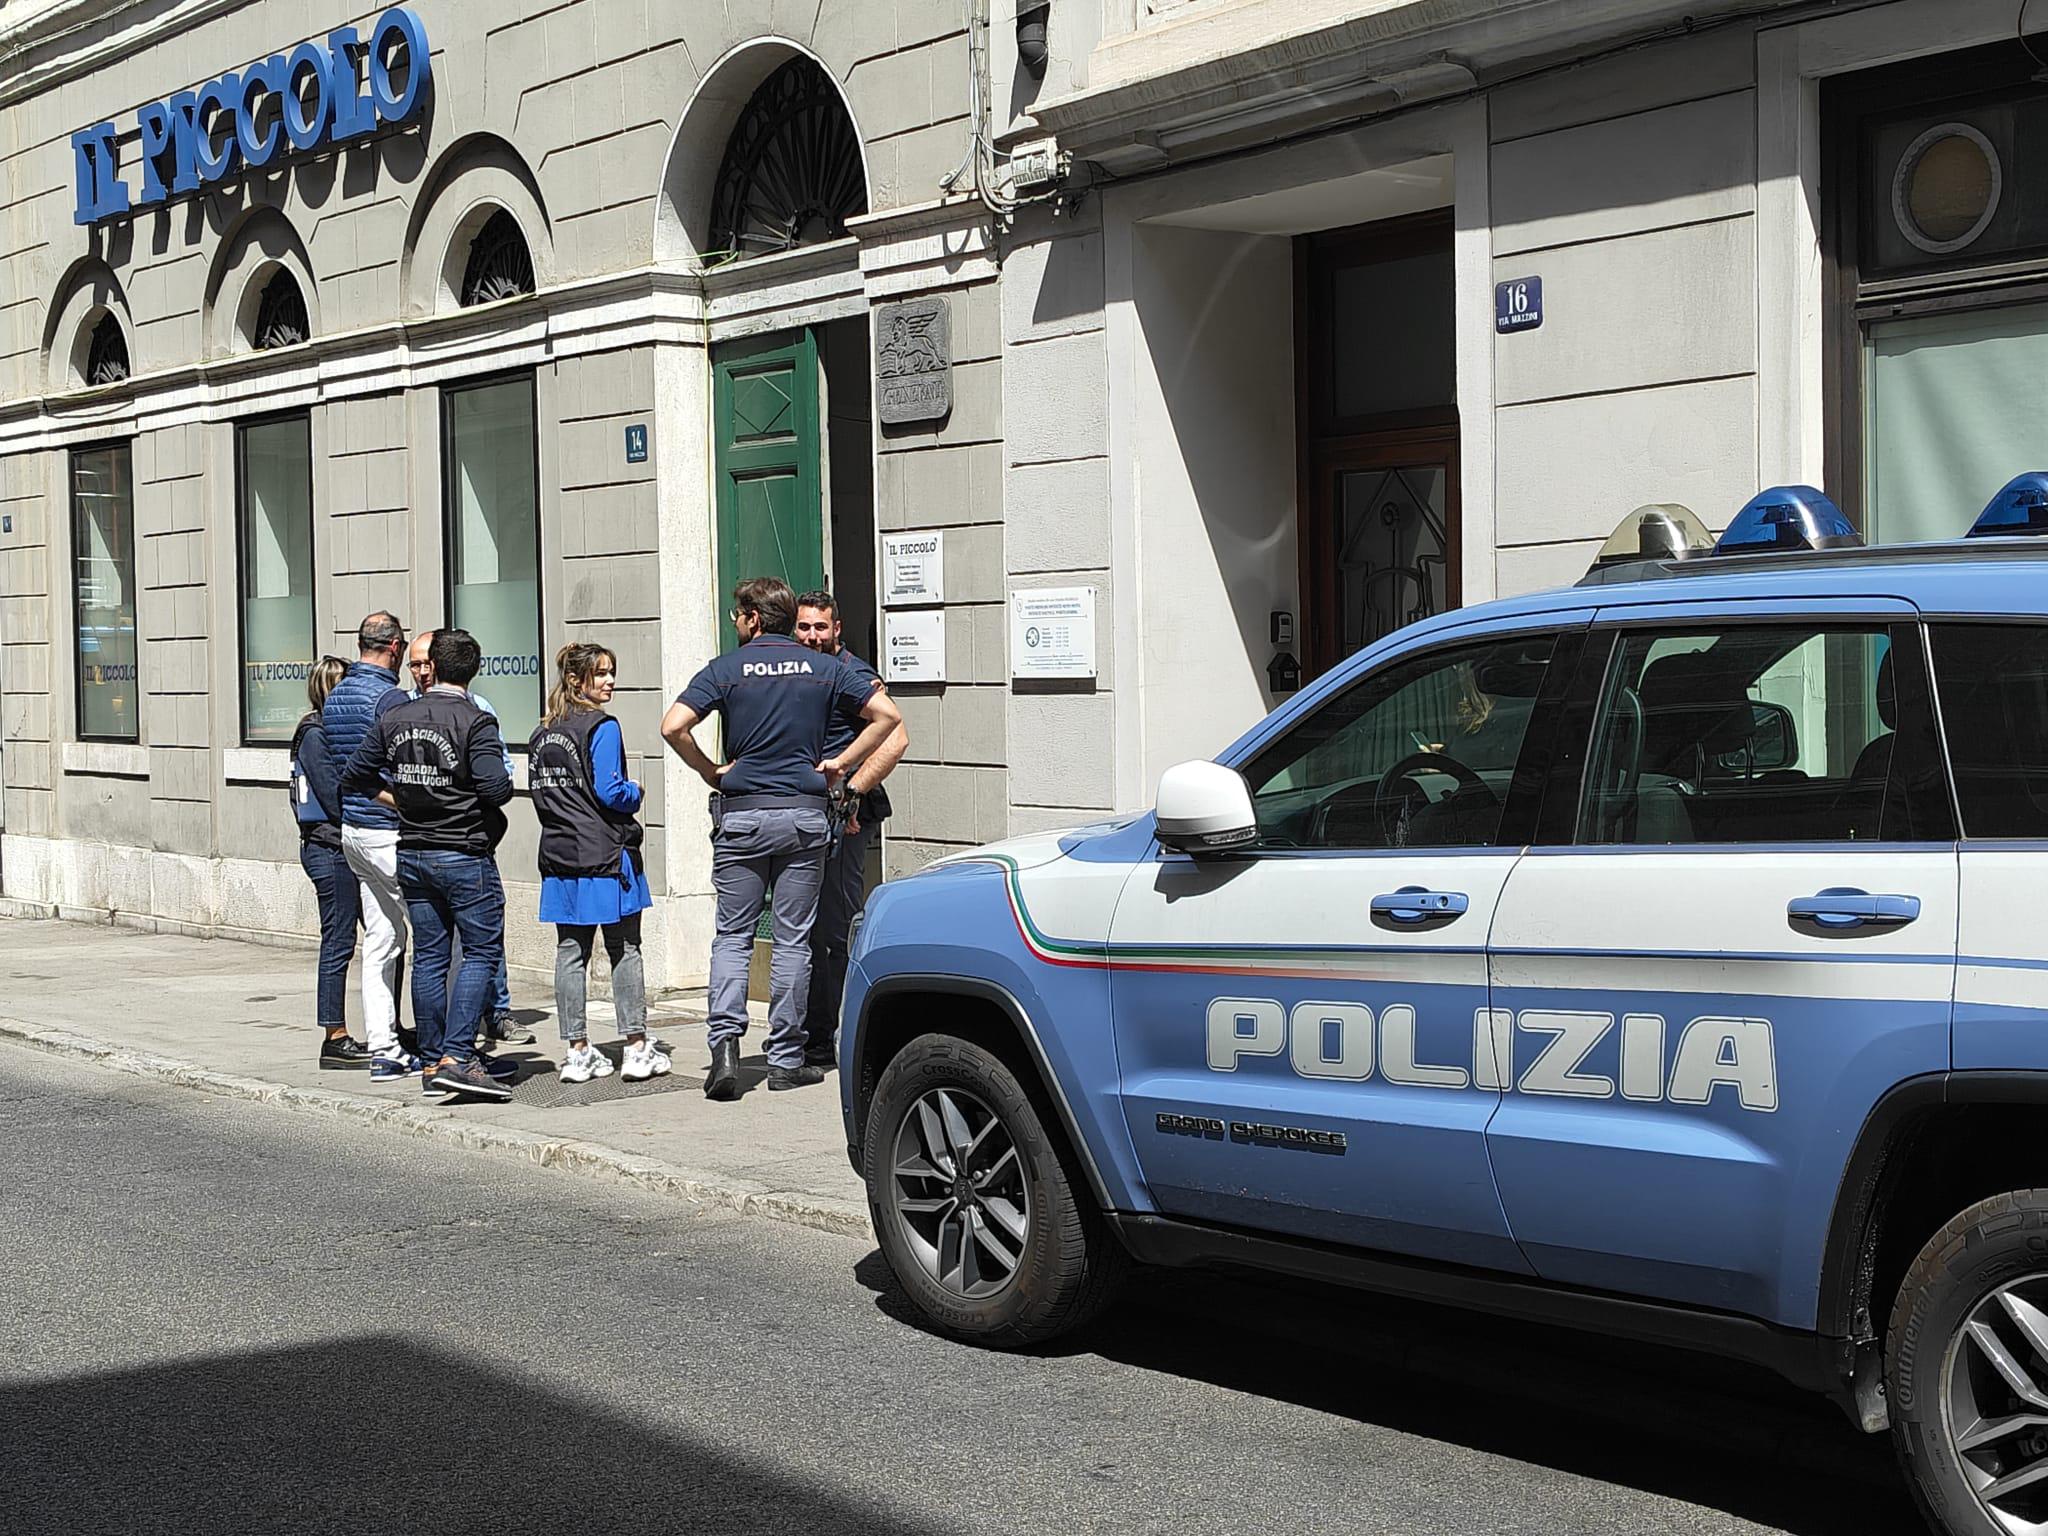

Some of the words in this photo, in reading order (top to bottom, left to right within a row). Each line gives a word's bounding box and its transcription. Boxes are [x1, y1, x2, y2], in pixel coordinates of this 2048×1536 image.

[71, 121, 129, 226] IL
[137, 7, 431, 204] PICCOLO
[1507, 283, 1528, 315] 16
[631, 430, 642, 451] 14
[889, 544, 898, 556] IL
[900, 541, 937, 556] PICCOLO
[251, 665, 263, 681] IL
[479, 654, 539, 676] PICCOLO
[743, 660, 813, 677] POLIZIA
[412, 728, 459, 769] SCIENTIFICA
[397, 763, 438, 776] SQUADRA
[1205, 996, 1779, 1113] POLIZIA
[1156, 1112, 1226, 1132] GRAND
[1230, 1120, 1348, 1147] CHEROKEE
[1897, 1285, 1932, 1411] Continental
